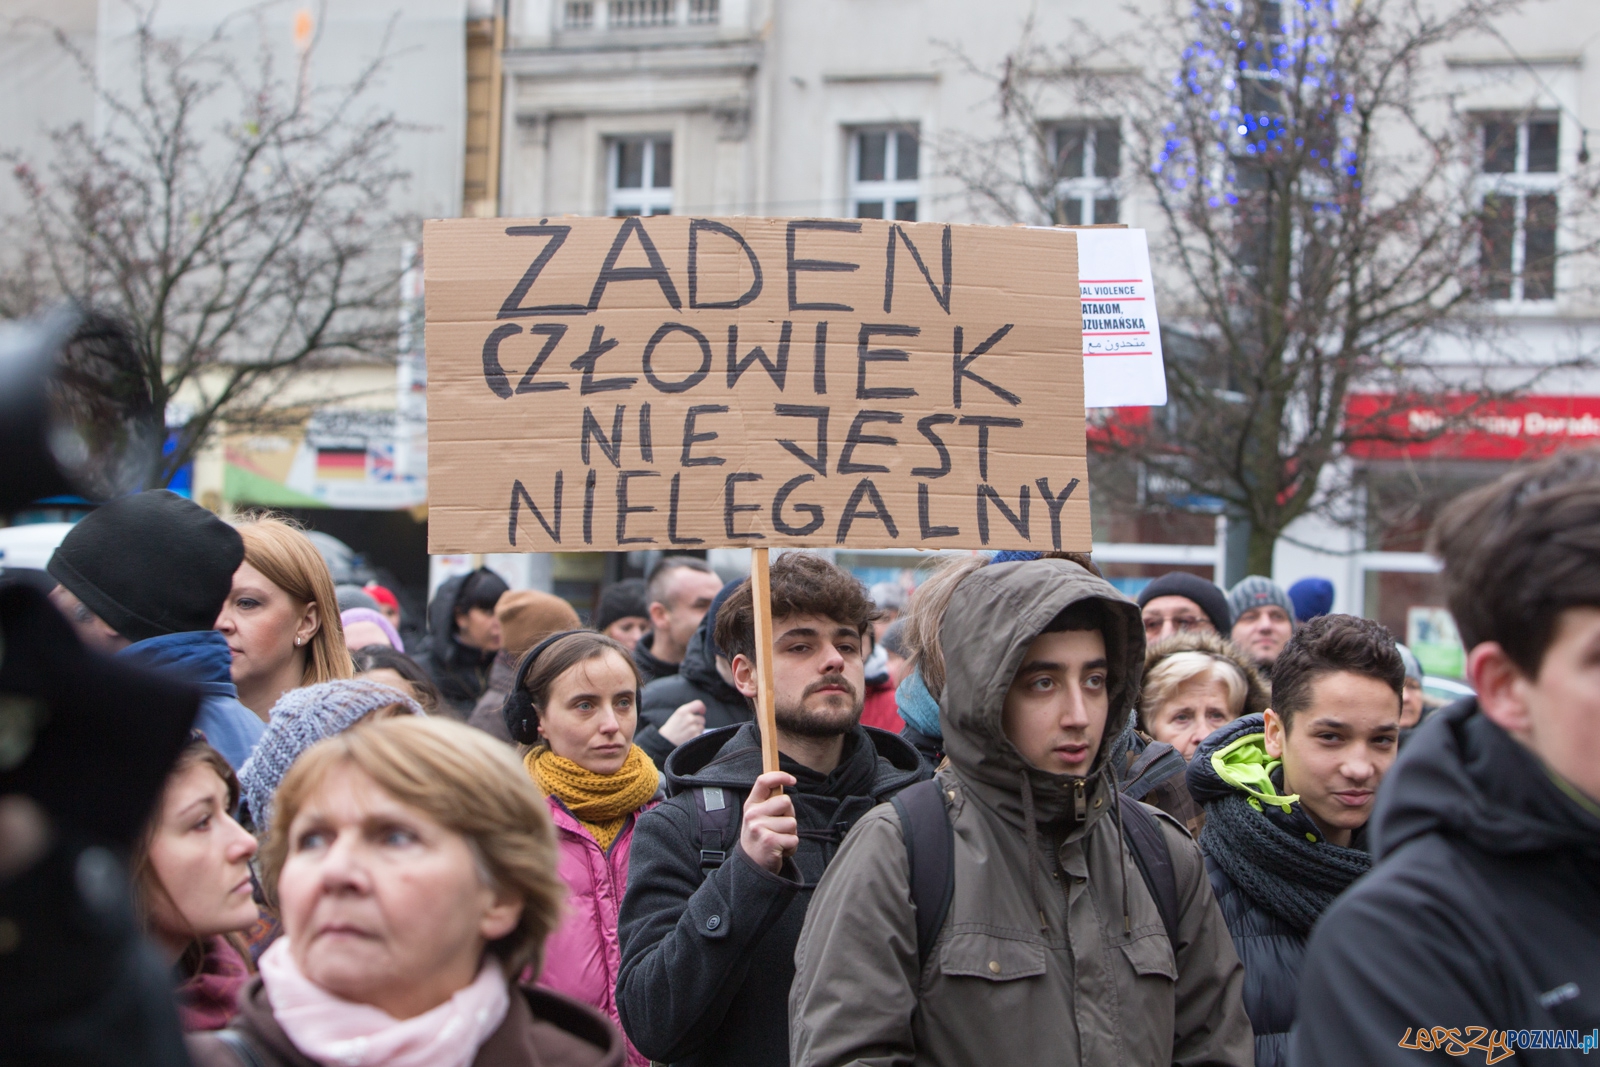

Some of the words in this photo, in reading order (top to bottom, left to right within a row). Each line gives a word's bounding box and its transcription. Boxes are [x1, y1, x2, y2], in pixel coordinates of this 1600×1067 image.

[496, 218, 952, 320] ŻADEN
[1082, 303, 1124, 315] ATAKOM,
[1094, 286, 1136, 295] VIOLENCE
[482, 320, 1022, 409] CZŁOWIEK
[580, 401, 730, 468] NIE
[773, 402, 1024, 482] JEST
[508, 468, 1080, 551] NIELEGALNY
